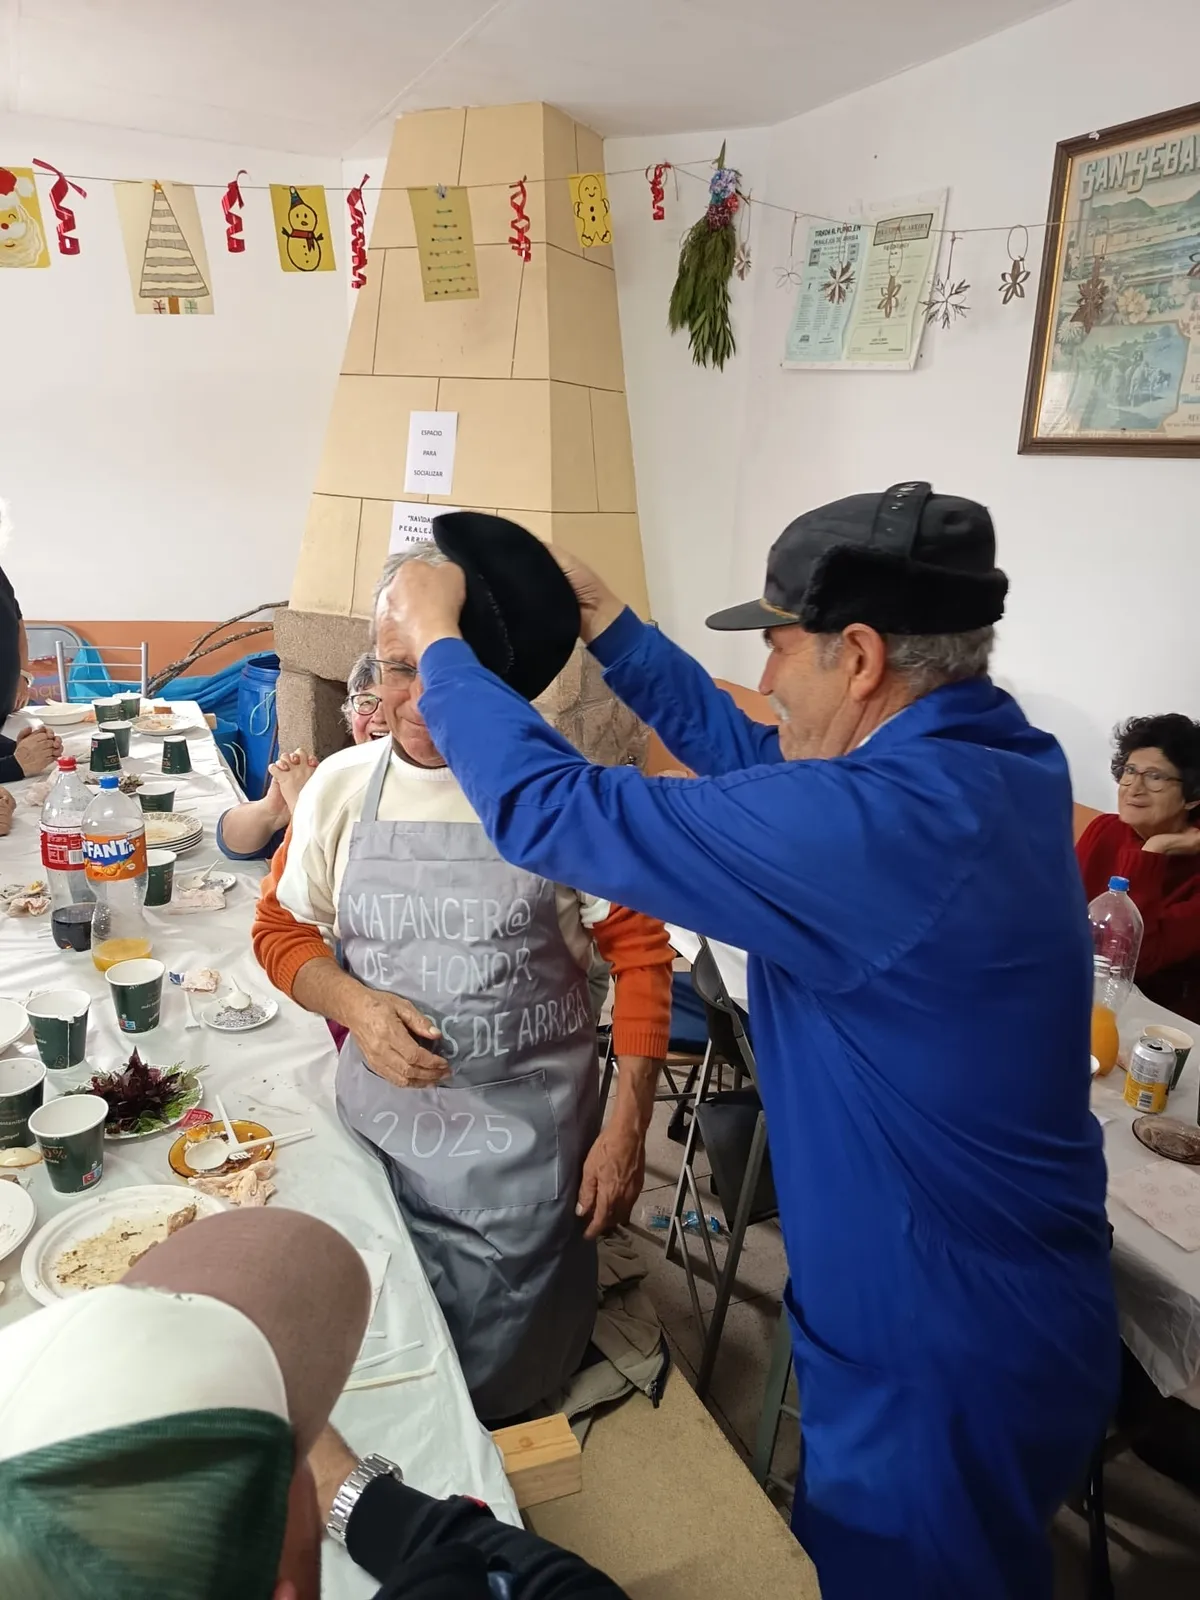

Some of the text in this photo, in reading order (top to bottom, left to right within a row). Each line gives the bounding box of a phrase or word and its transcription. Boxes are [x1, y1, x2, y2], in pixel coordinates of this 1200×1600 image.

[1080, 134, 1200, 201] SAN SEBA
[421, 429, 443, 437] ESPACIO
[413, 469, 443, 477] SOCIALIZAR
[398, 524, 432, 534] PERALEJ
[87, 838, 136, 859] FANTA
[347, 893, 531, 943] MATANCER@
[363, 947, 533, 995] DE HONOR
[473, 1011, 510, 1058] DE
[517, 986, 590, 1052] ARRIBA
[372, 1110, 512, 1158] 2025
